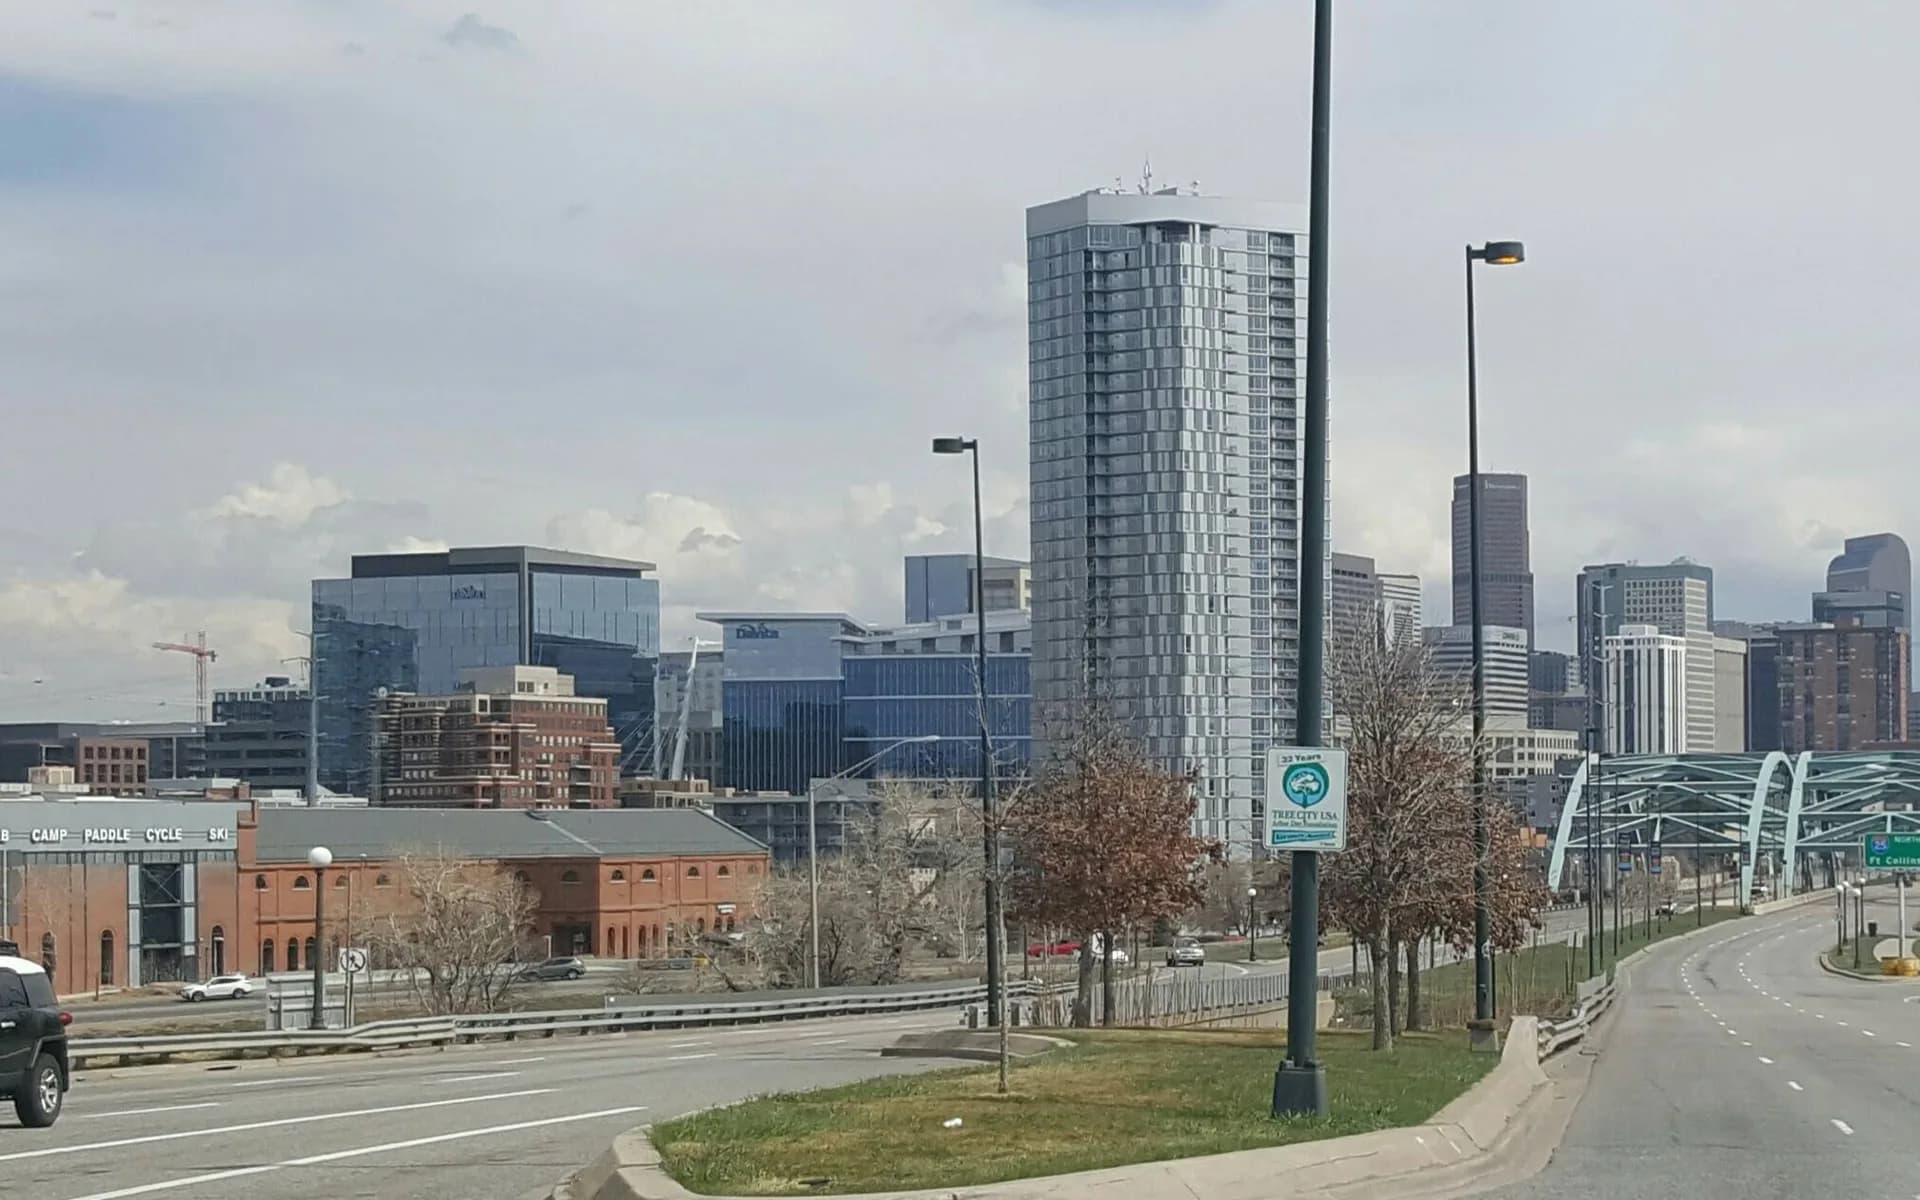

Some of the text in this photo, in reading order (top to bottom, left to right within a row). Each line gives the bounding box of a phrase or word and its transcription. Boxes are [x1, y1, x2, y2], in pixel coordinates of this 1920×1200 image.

[1272, 811, 1338, 822] TREE CITY USA
[32, 829, 67, 841] CAMP
[85, 829, 130, 841] PADDLE
[146, 828, 182, 840] CYCLE
[210, 828, 228, 840] SKI
[1870, 856, 1881, 865] Ft
